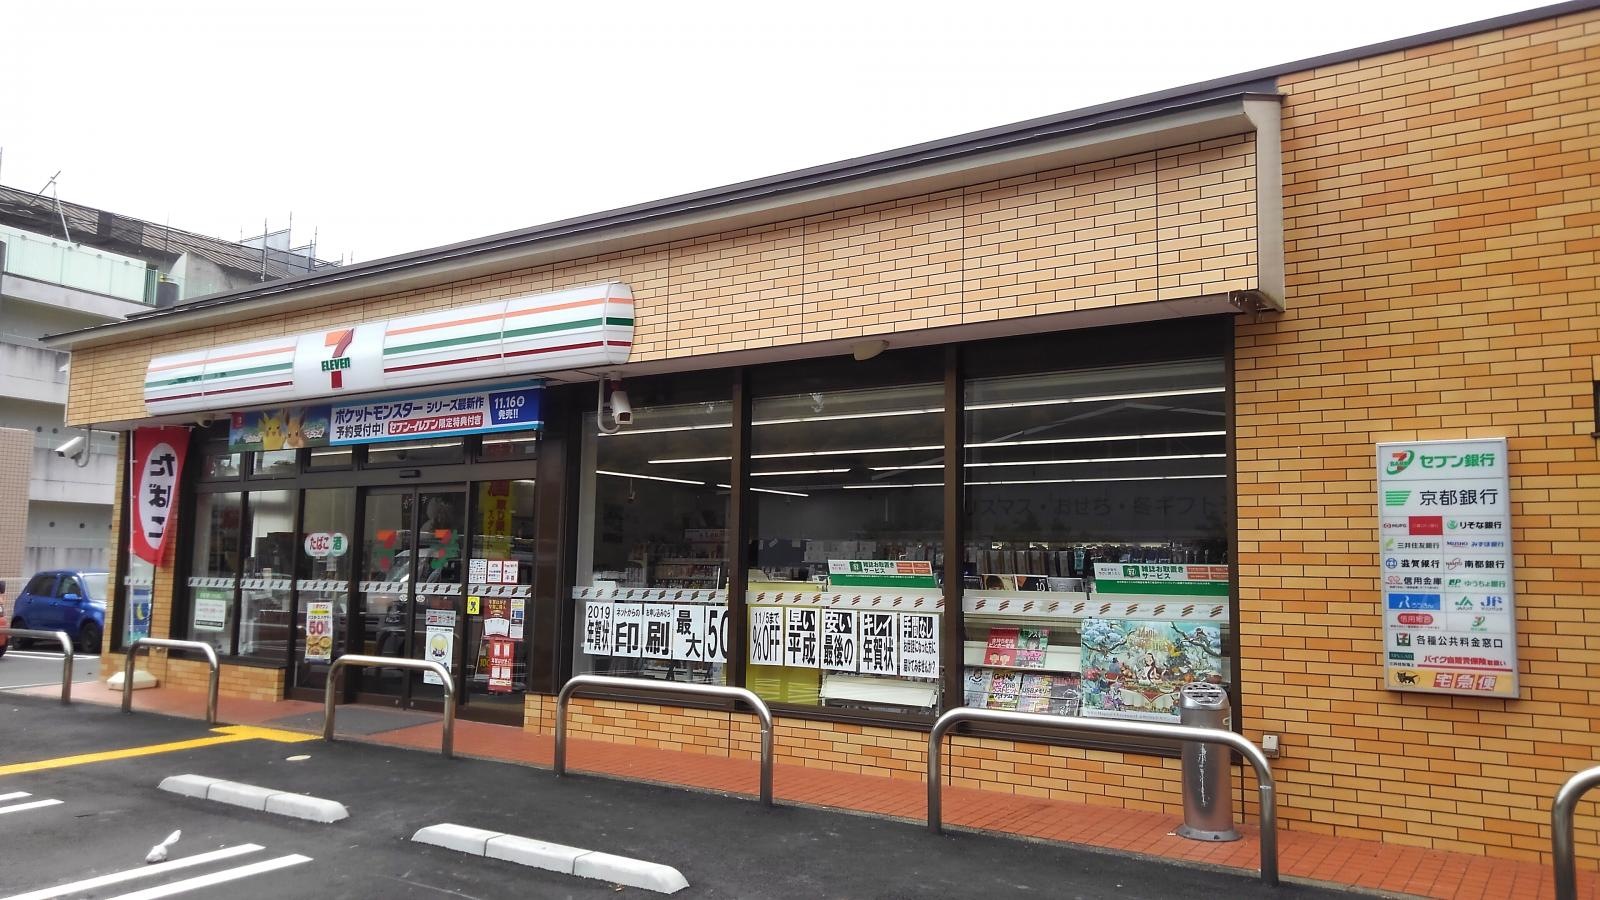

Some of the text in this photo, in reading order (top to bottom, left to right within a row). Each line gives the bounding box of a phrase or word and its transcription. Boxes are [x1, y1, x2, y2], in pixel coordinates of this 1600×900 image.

[325, 328, 354, 388] 7
[335, 396, 485, 424] ポケットモンスター シリーズ最新作
[336, 423, 384, 440] 予約受付中!
[1420, 453, 1495, 468] セブン銀行
[1420, 489, 1498, 506] 京都銀行
[1460, 521, 1502, 530] りそな銀行
[310, 536, 343, 551] たばこ 酒
[1401, 559, 1440, 569] 滋賀銀行
[1465, 560, 1505, 569] 南都銀行
[1404, 576, 1442, 586] 信用金庫
[1464, 579, 1506, 588] ゆうちょ銀行
[588, 606, 611, 619] 2019
[616, 608, 640, 617] ネットからの
[754, 612, 779, 624] 11/5まで
[790, 610, 816, 631] 早い
[825, 611, 853, 634] 安い
[864, 614, 893, 637] キレイ
[904, 616, 934, 639] 手間なし
[587, 620, 609, 651] 年賀状
[753, 625, 780, 661] %OFF
[1416, 636, 1503, 648] 各種公共料金窓口
[788, 633, 817, 665] 平成
[824, 635, 854, 667] 最後の
[863, 637, 894, 671] 年賀状
[1434, 673, 1497, 691] 宅急便
